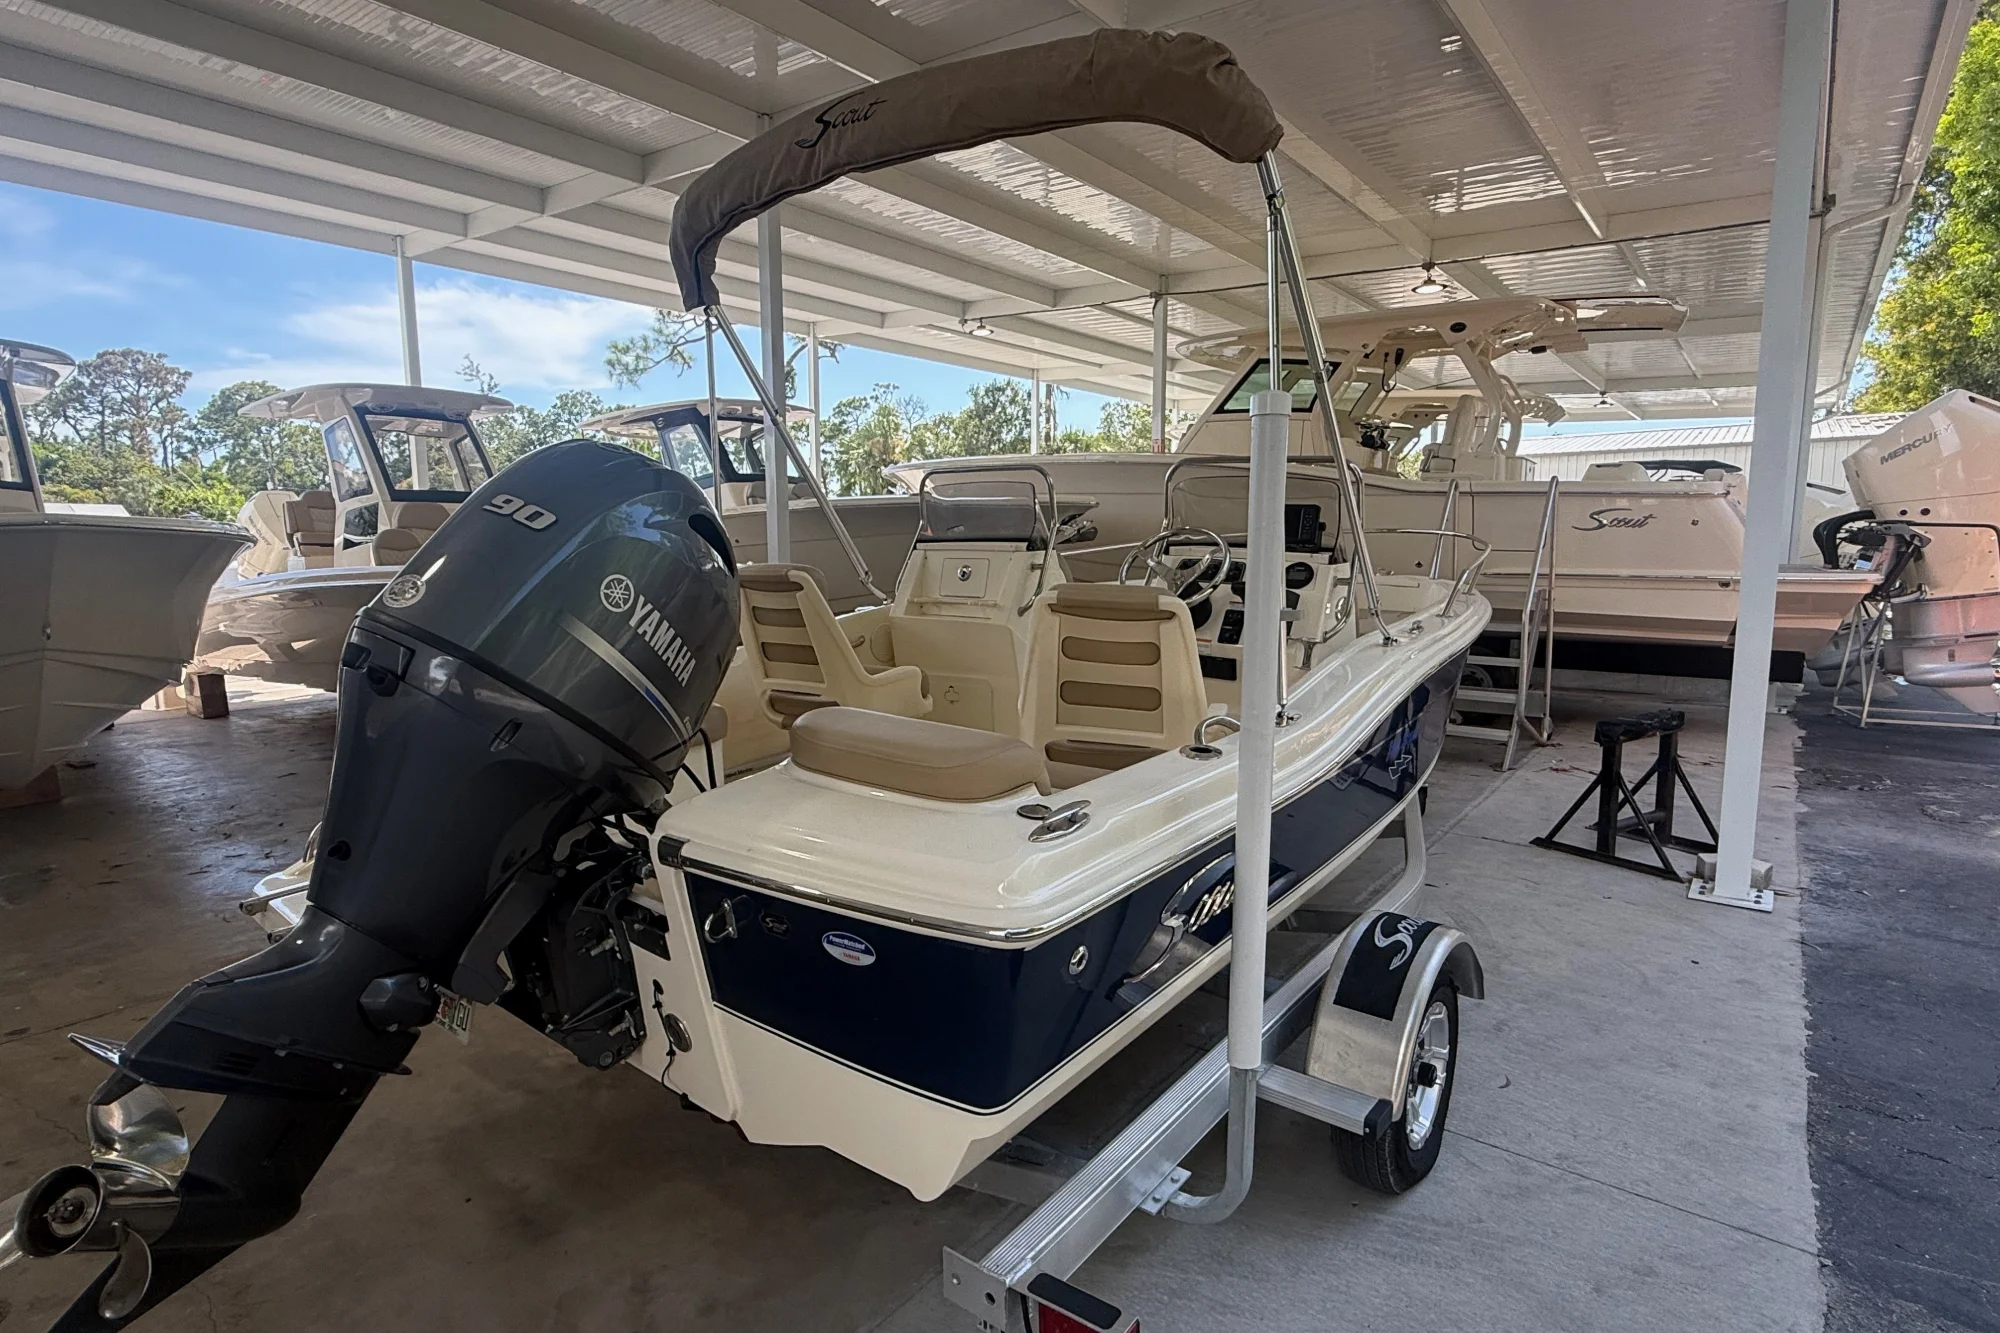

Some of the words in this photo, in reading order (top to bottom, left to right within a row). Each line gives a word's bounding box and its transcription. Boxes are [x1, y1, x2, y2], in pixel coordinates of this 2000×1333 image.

[794, 91, 887, 149] Scout
[1880, 423, 1953, 465] MERCURY
[482, 493, 557, 530] 90
[1571, 507, 1658, 532] Scout
[629, 594, 696, 688] YAMAHA
